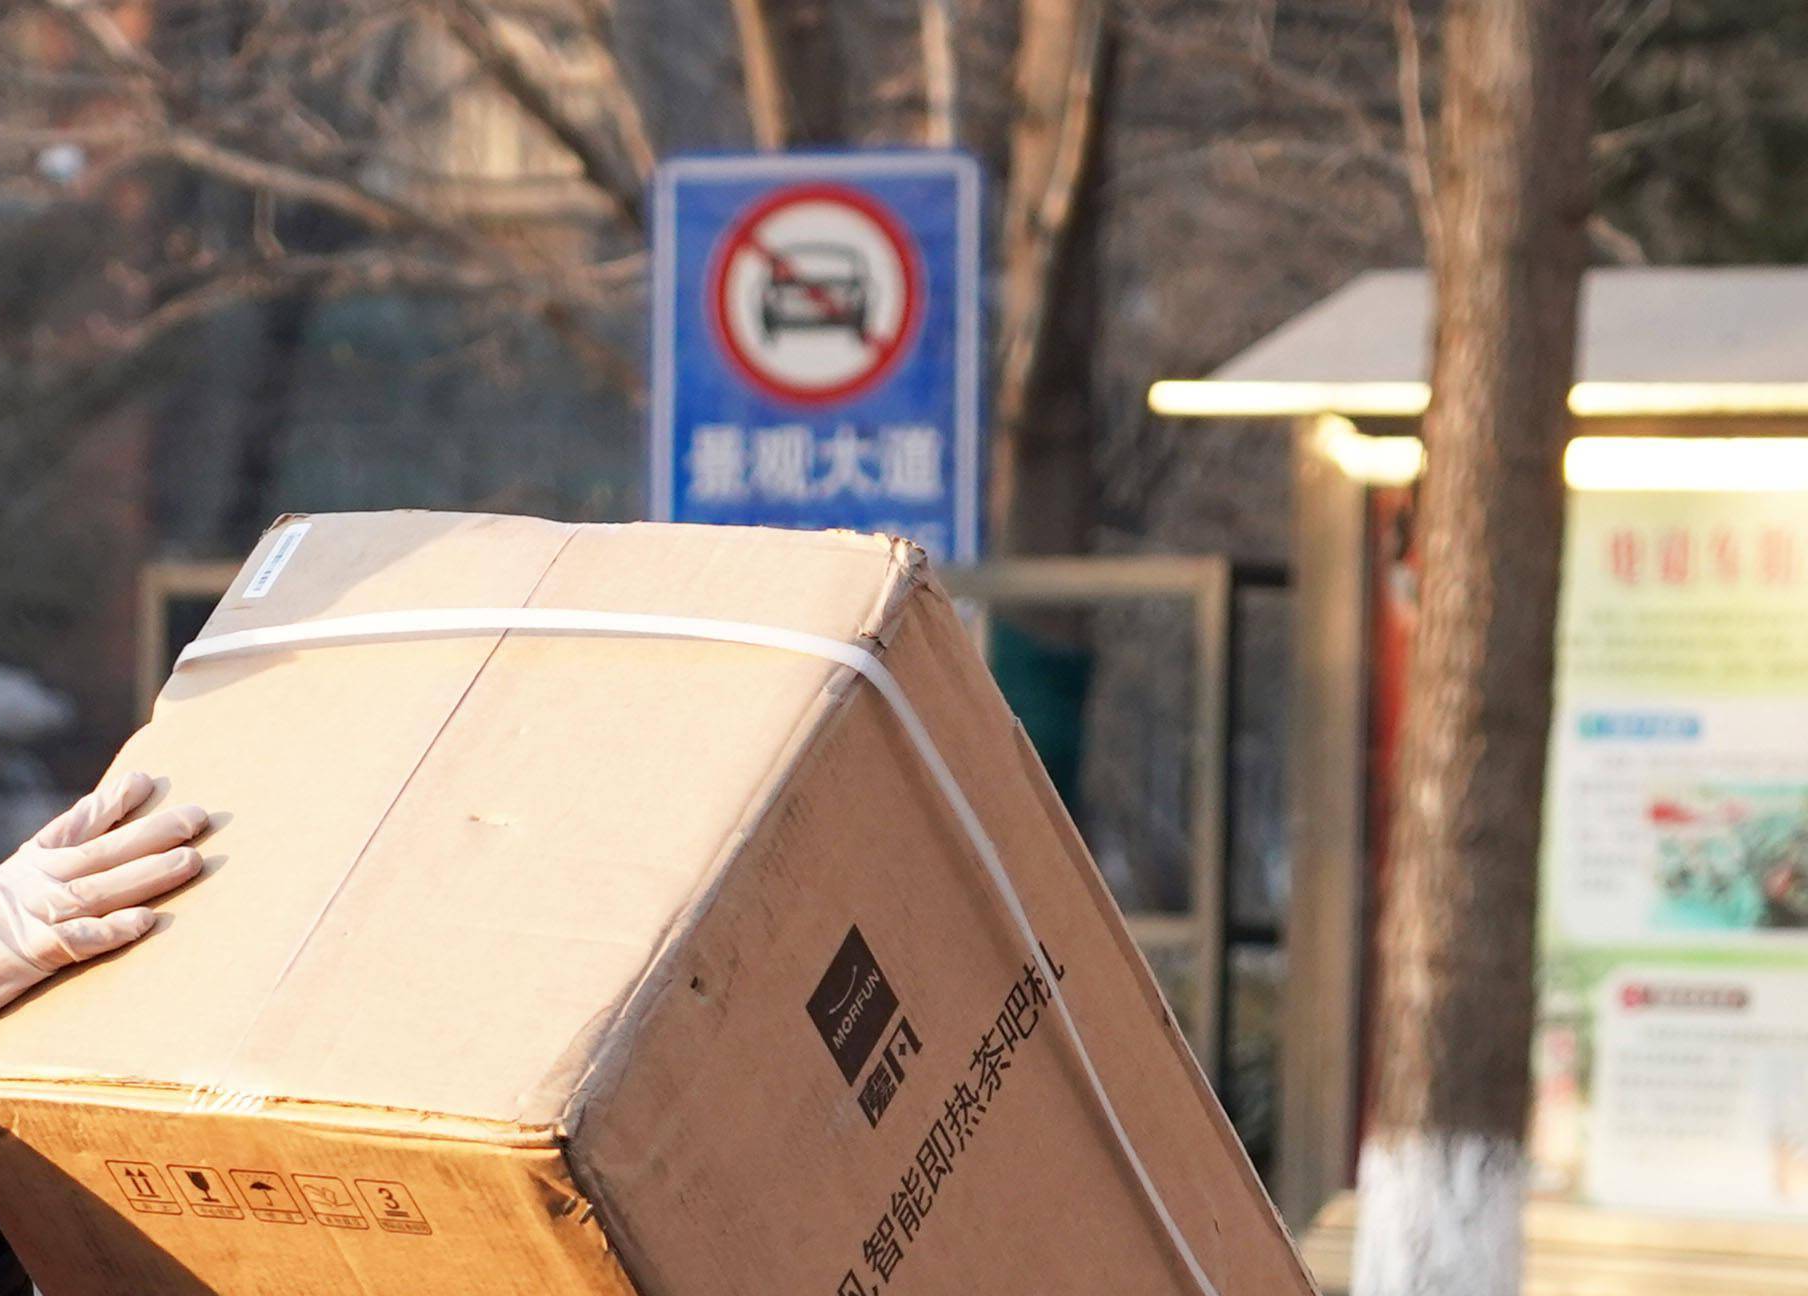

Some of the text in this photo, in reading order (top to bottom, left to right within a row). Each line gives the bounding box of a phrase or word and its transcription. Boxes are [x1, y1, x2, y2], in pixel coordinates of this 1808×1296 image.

[691, 424, 943, 502] 景观大道
[832, 968, 881, 1050] MORFUN
[378, 1187, 400, 1210] 3
